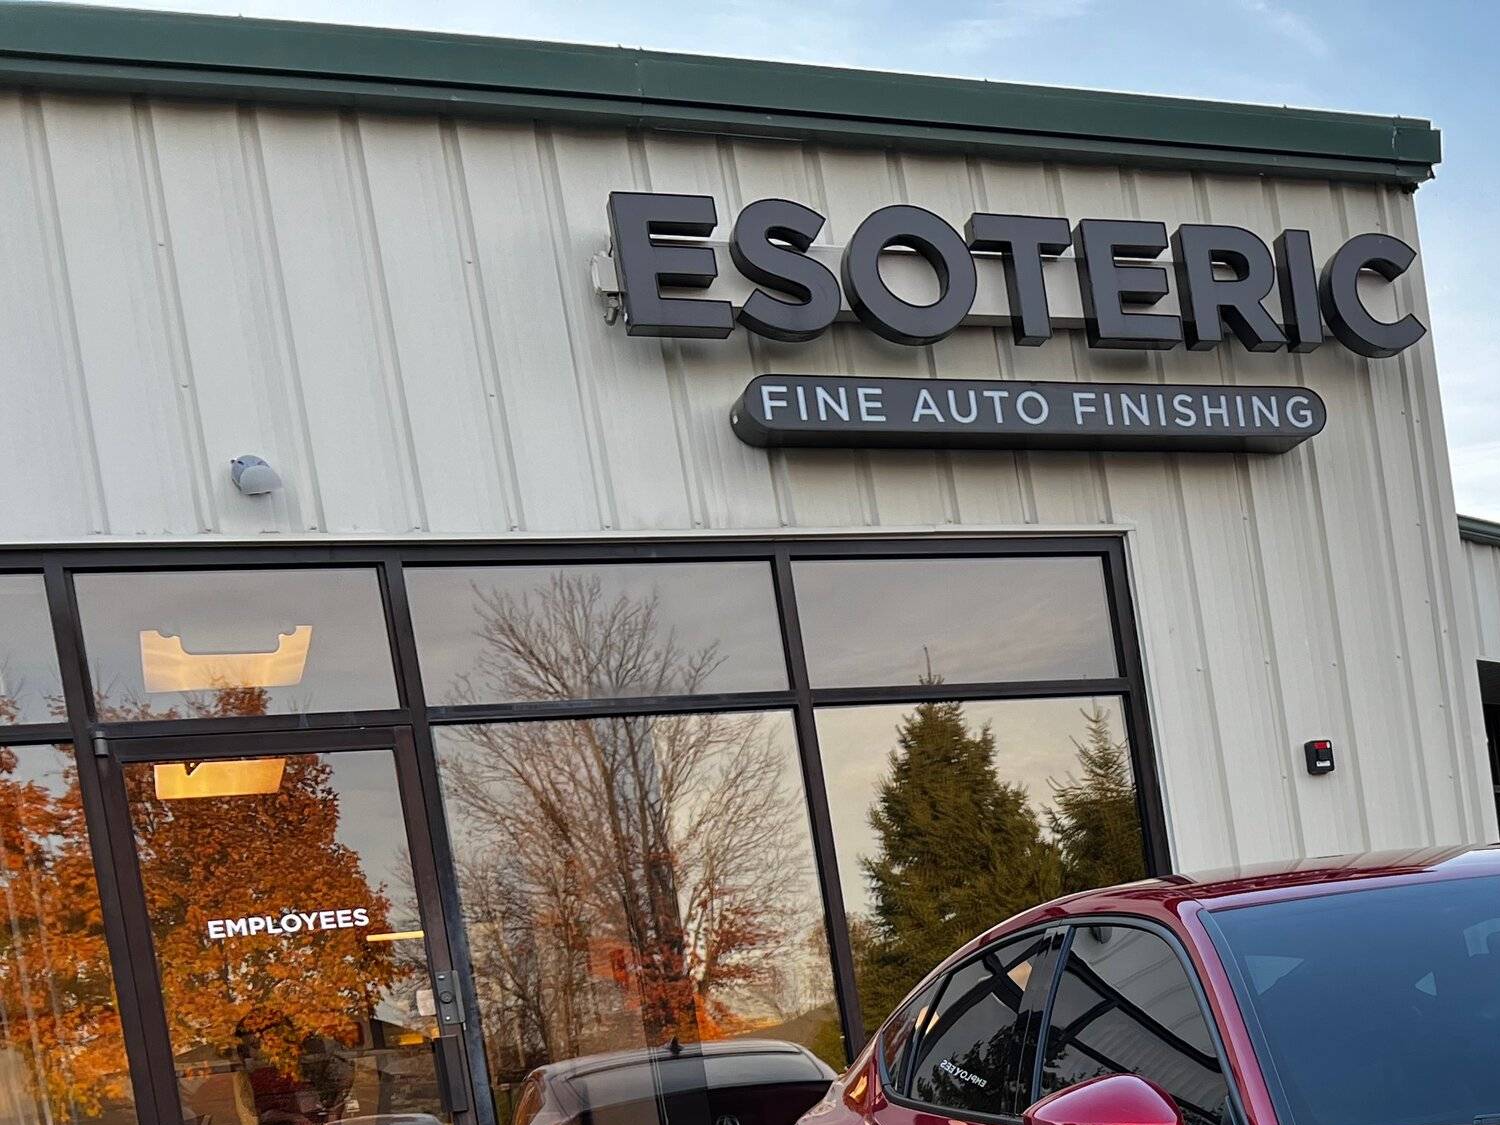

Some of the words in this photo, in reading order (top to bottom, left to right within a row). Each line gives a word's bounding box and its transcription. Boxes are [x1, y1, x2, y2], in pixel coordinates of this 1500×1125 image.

[609, 191, 1427, 358] ESOTERIC
[760, 384, 887, 423] FINE
[911, 389, 1050, 426] AUTO
[1073, 392, 1315, 430] FINISHING
[207, 908, 370, 939] EMPLOYEES
